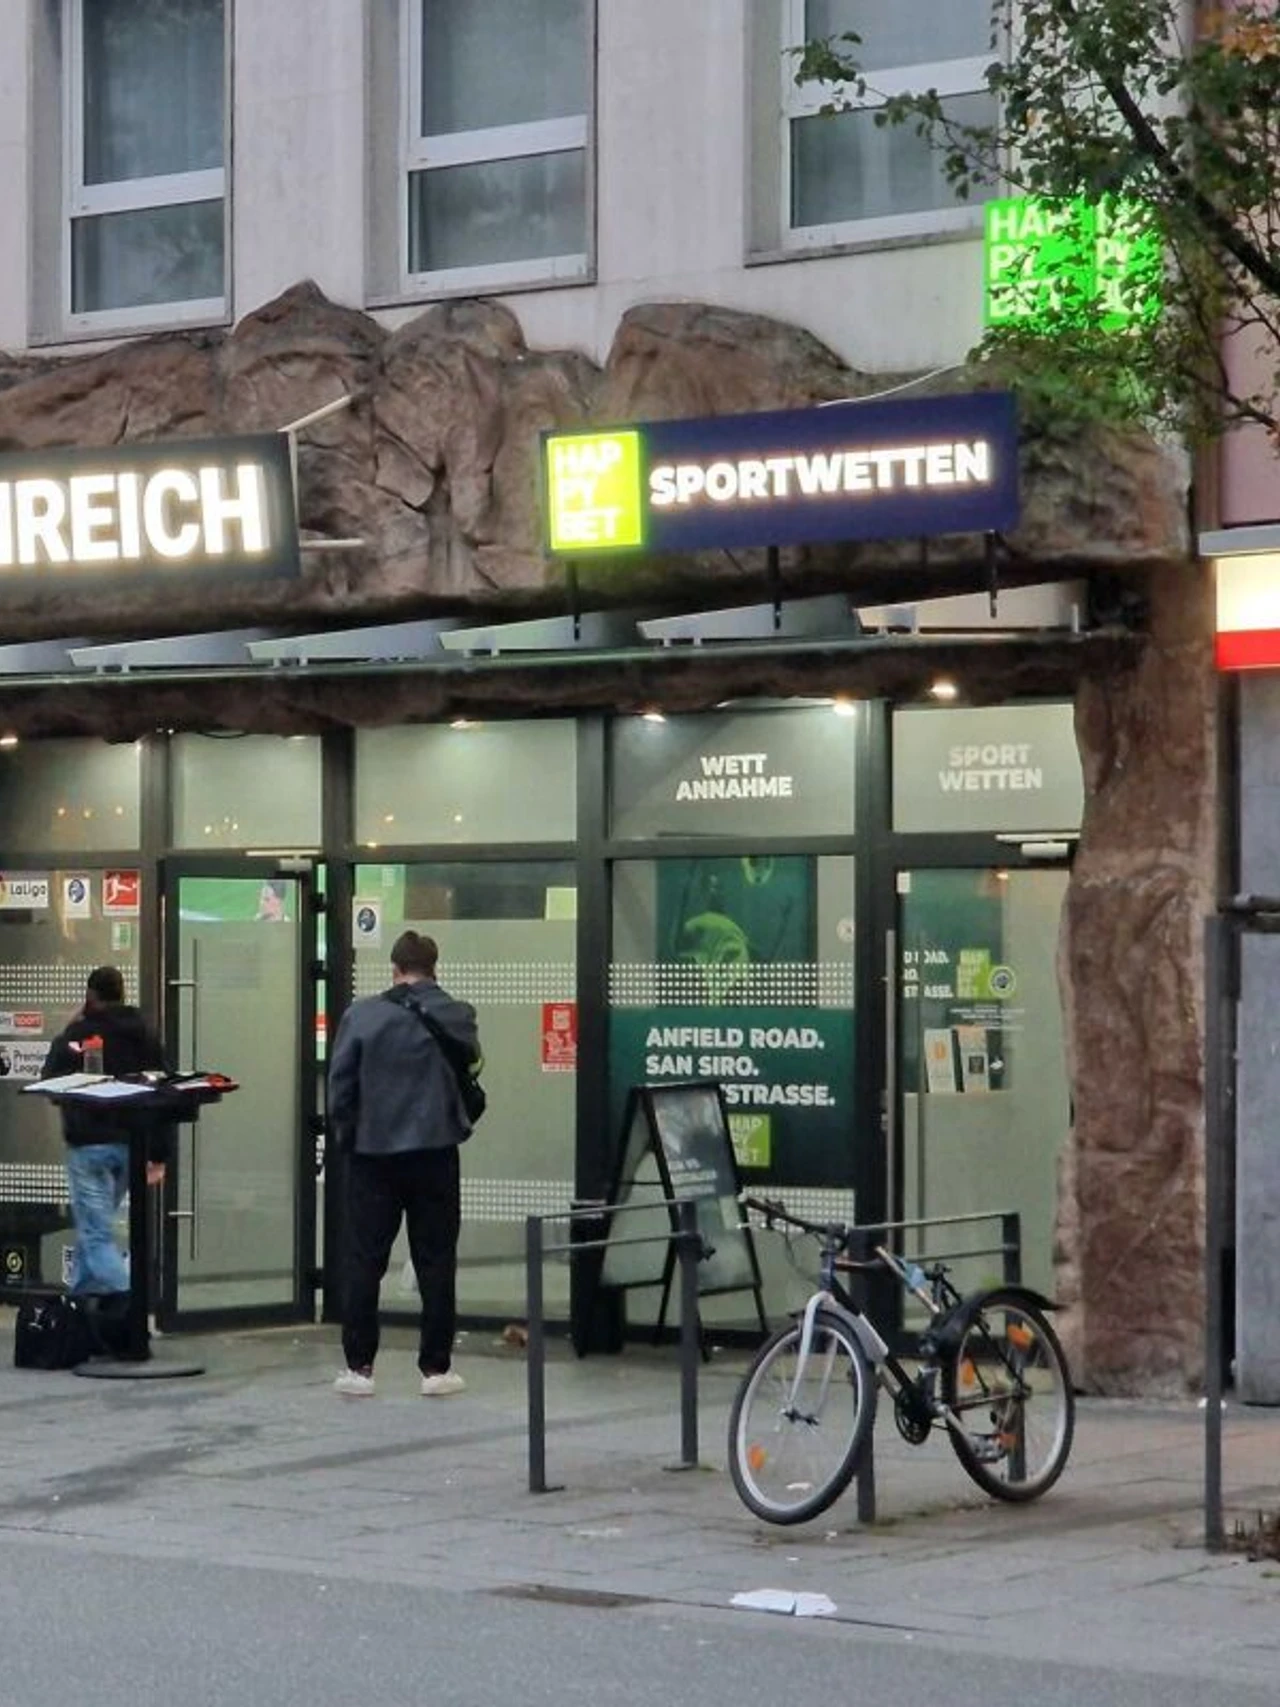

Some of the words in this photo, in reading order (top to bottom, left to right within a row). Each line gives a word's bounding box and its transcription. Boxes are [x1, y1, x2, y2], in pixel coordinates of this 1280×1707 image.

[554, 440, 624, 475] HAP
[648, 441, 990, 506] SPORTWETTEN
[558, 478, 598, 508] PY
[558, 508, 623, 541] BET
[700, 754, 768, 776] WETT
[948, 744, 1033, 769] SPORT
[676, 776, 794, 801] ANNAHME
[938, 768, 1043, 792] WETTEN
[11, 881, 47, 897] LaLiga
[646, 1028, 744, 1048] ANFIELD
[749, 1028, 825, 1049] ROAD.
[646, 1056, 693, 1075] SAN
[697, 1056, 760, 1076] SIRO.
[720, 1083, 836, 1105] STRASSE.
